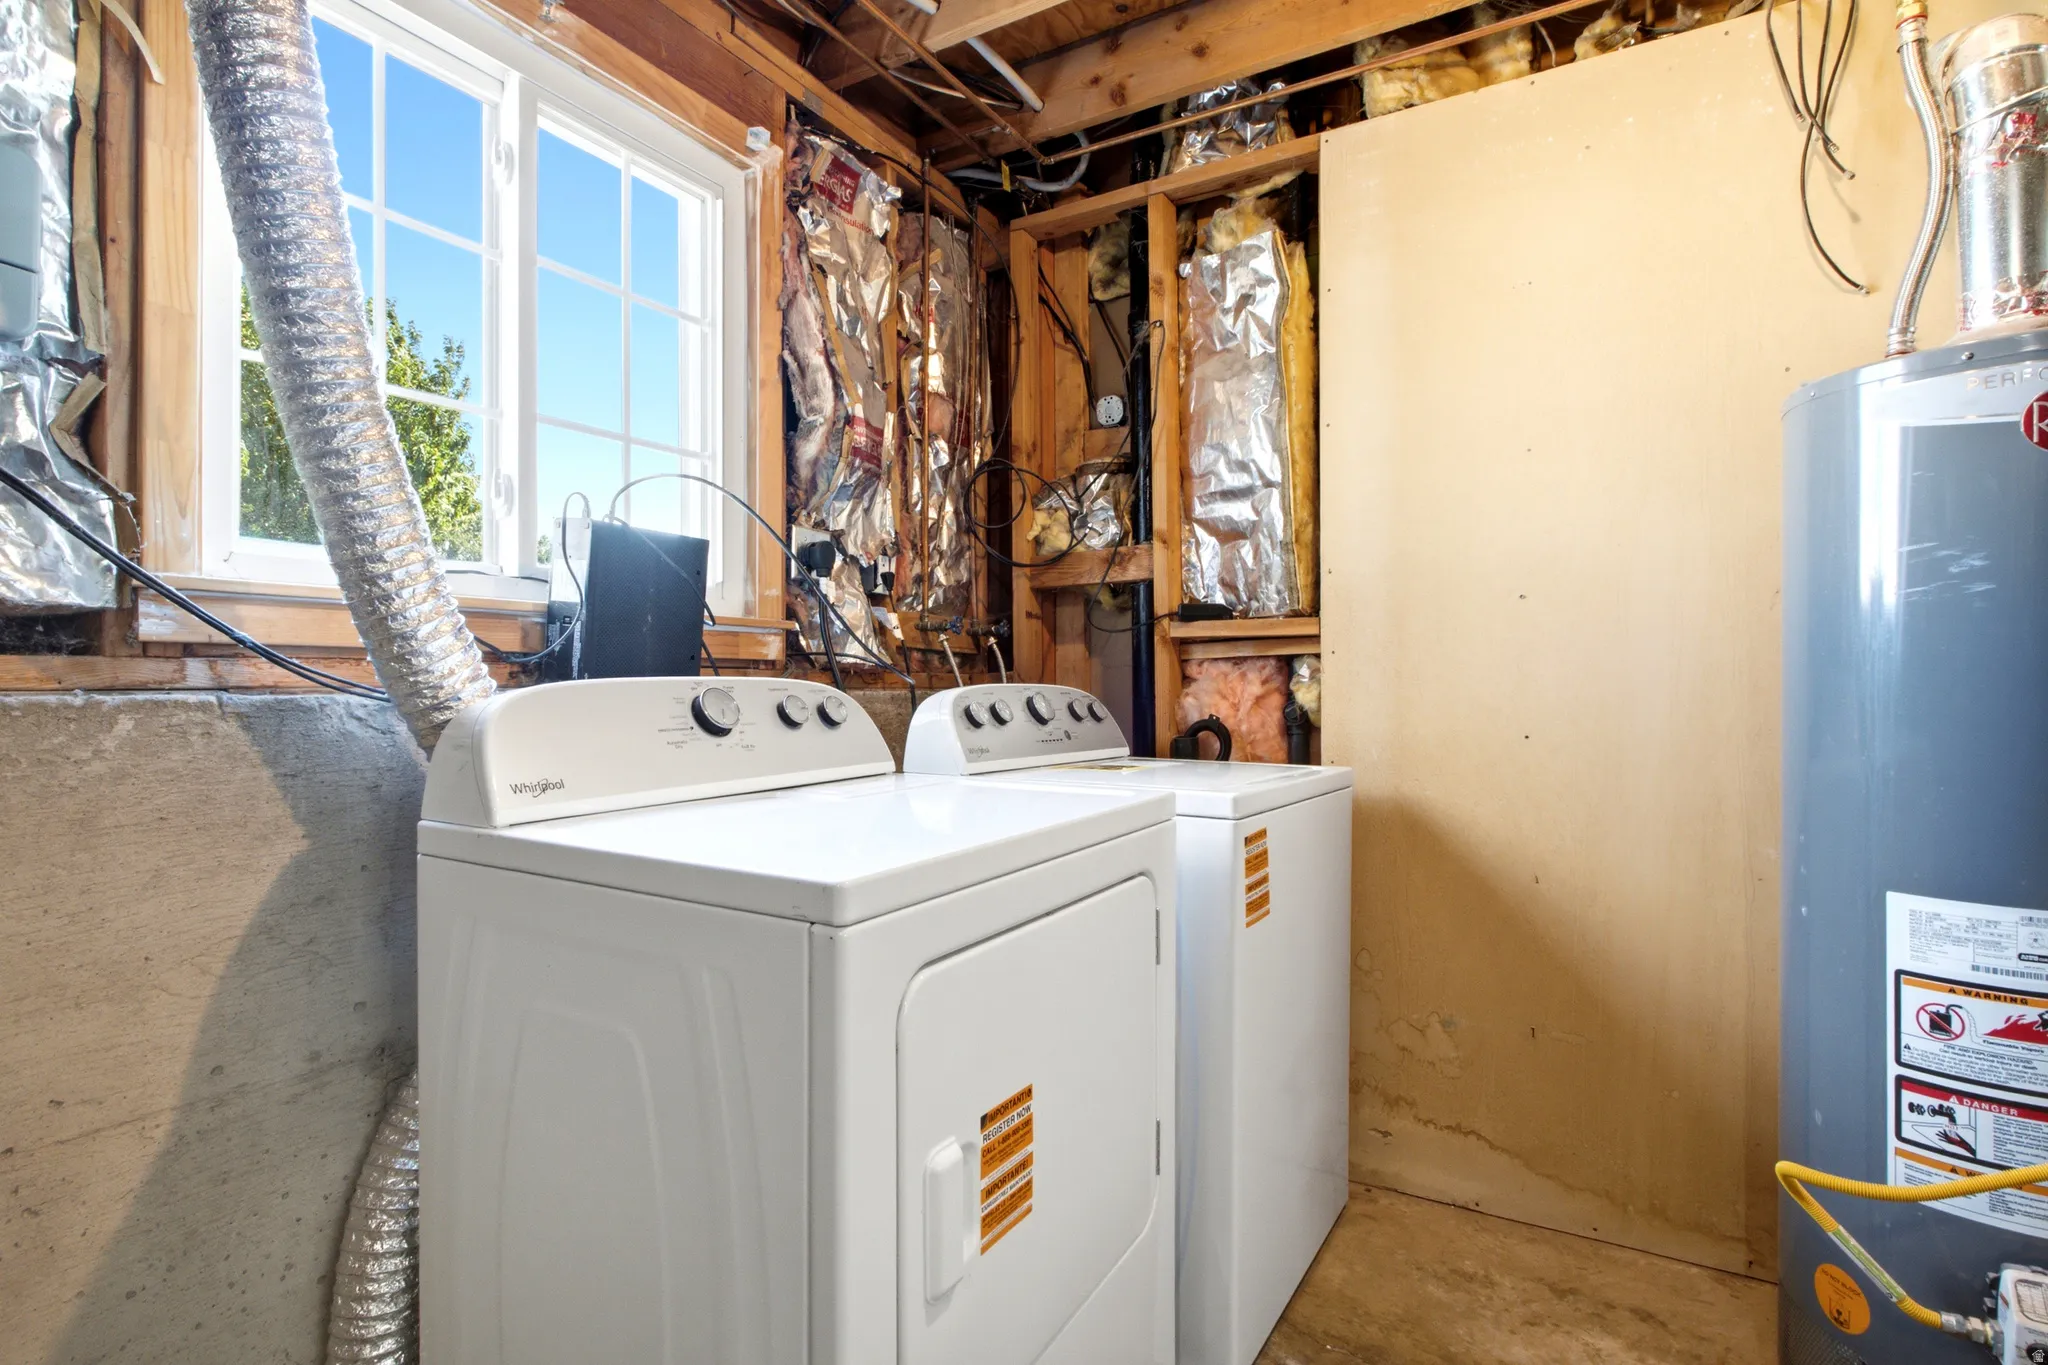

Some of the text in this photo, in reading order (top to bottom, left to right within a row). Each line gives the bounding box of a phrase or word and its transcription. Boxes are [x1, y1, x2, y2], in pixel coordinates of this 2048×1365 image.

[509, 778, 565, 798] Whirlpool
[1963, 989, 2028, 1006] WARNING
[1963, 1098, 2018, 1116] DANGER
[983, 1103, 1032, 1144] REGISTER NOW
